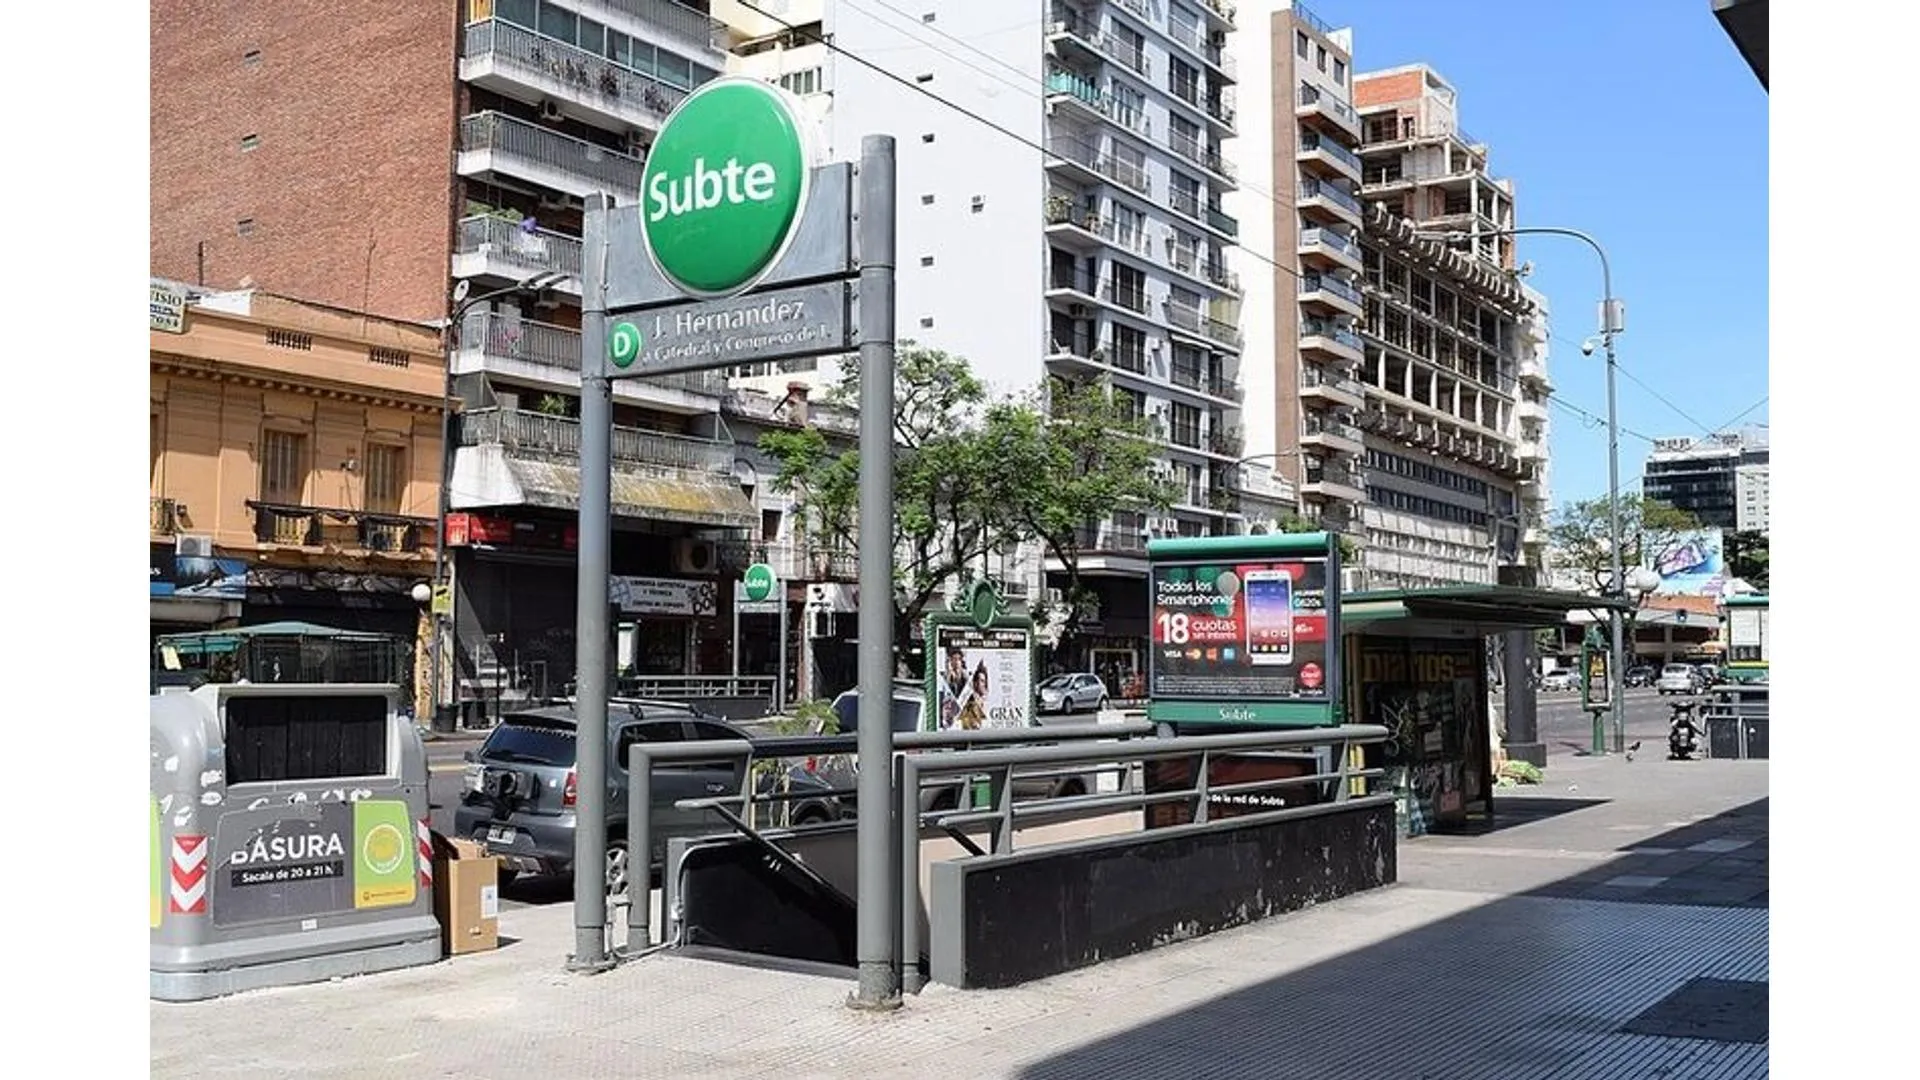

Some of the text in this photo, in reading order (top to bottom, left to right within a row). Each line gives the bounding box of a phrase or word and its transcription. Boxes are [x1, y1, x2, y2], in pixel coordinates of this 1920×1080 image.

[650, 157, 777, 222] Subte
[652, 298, 804, 339] J. Hernandez
[613, 331, 632, 358] D
[654, 342, 711, 361] Catedral
[725, 329, 793, 351] Congreso
[1157, 580, 1213, 592] Todos los
[1157, 593, 1236, 606] Smartphones
[1157, 612, 1237, 644] 18 cuotas
[989, 706, 1023, 721] GRAN
[1260, 796, 1285, 806] Subte
[275, 869, 289, 880] de
[290, 867, 304, 879] 20
[314, 865, 324, 876] 21
